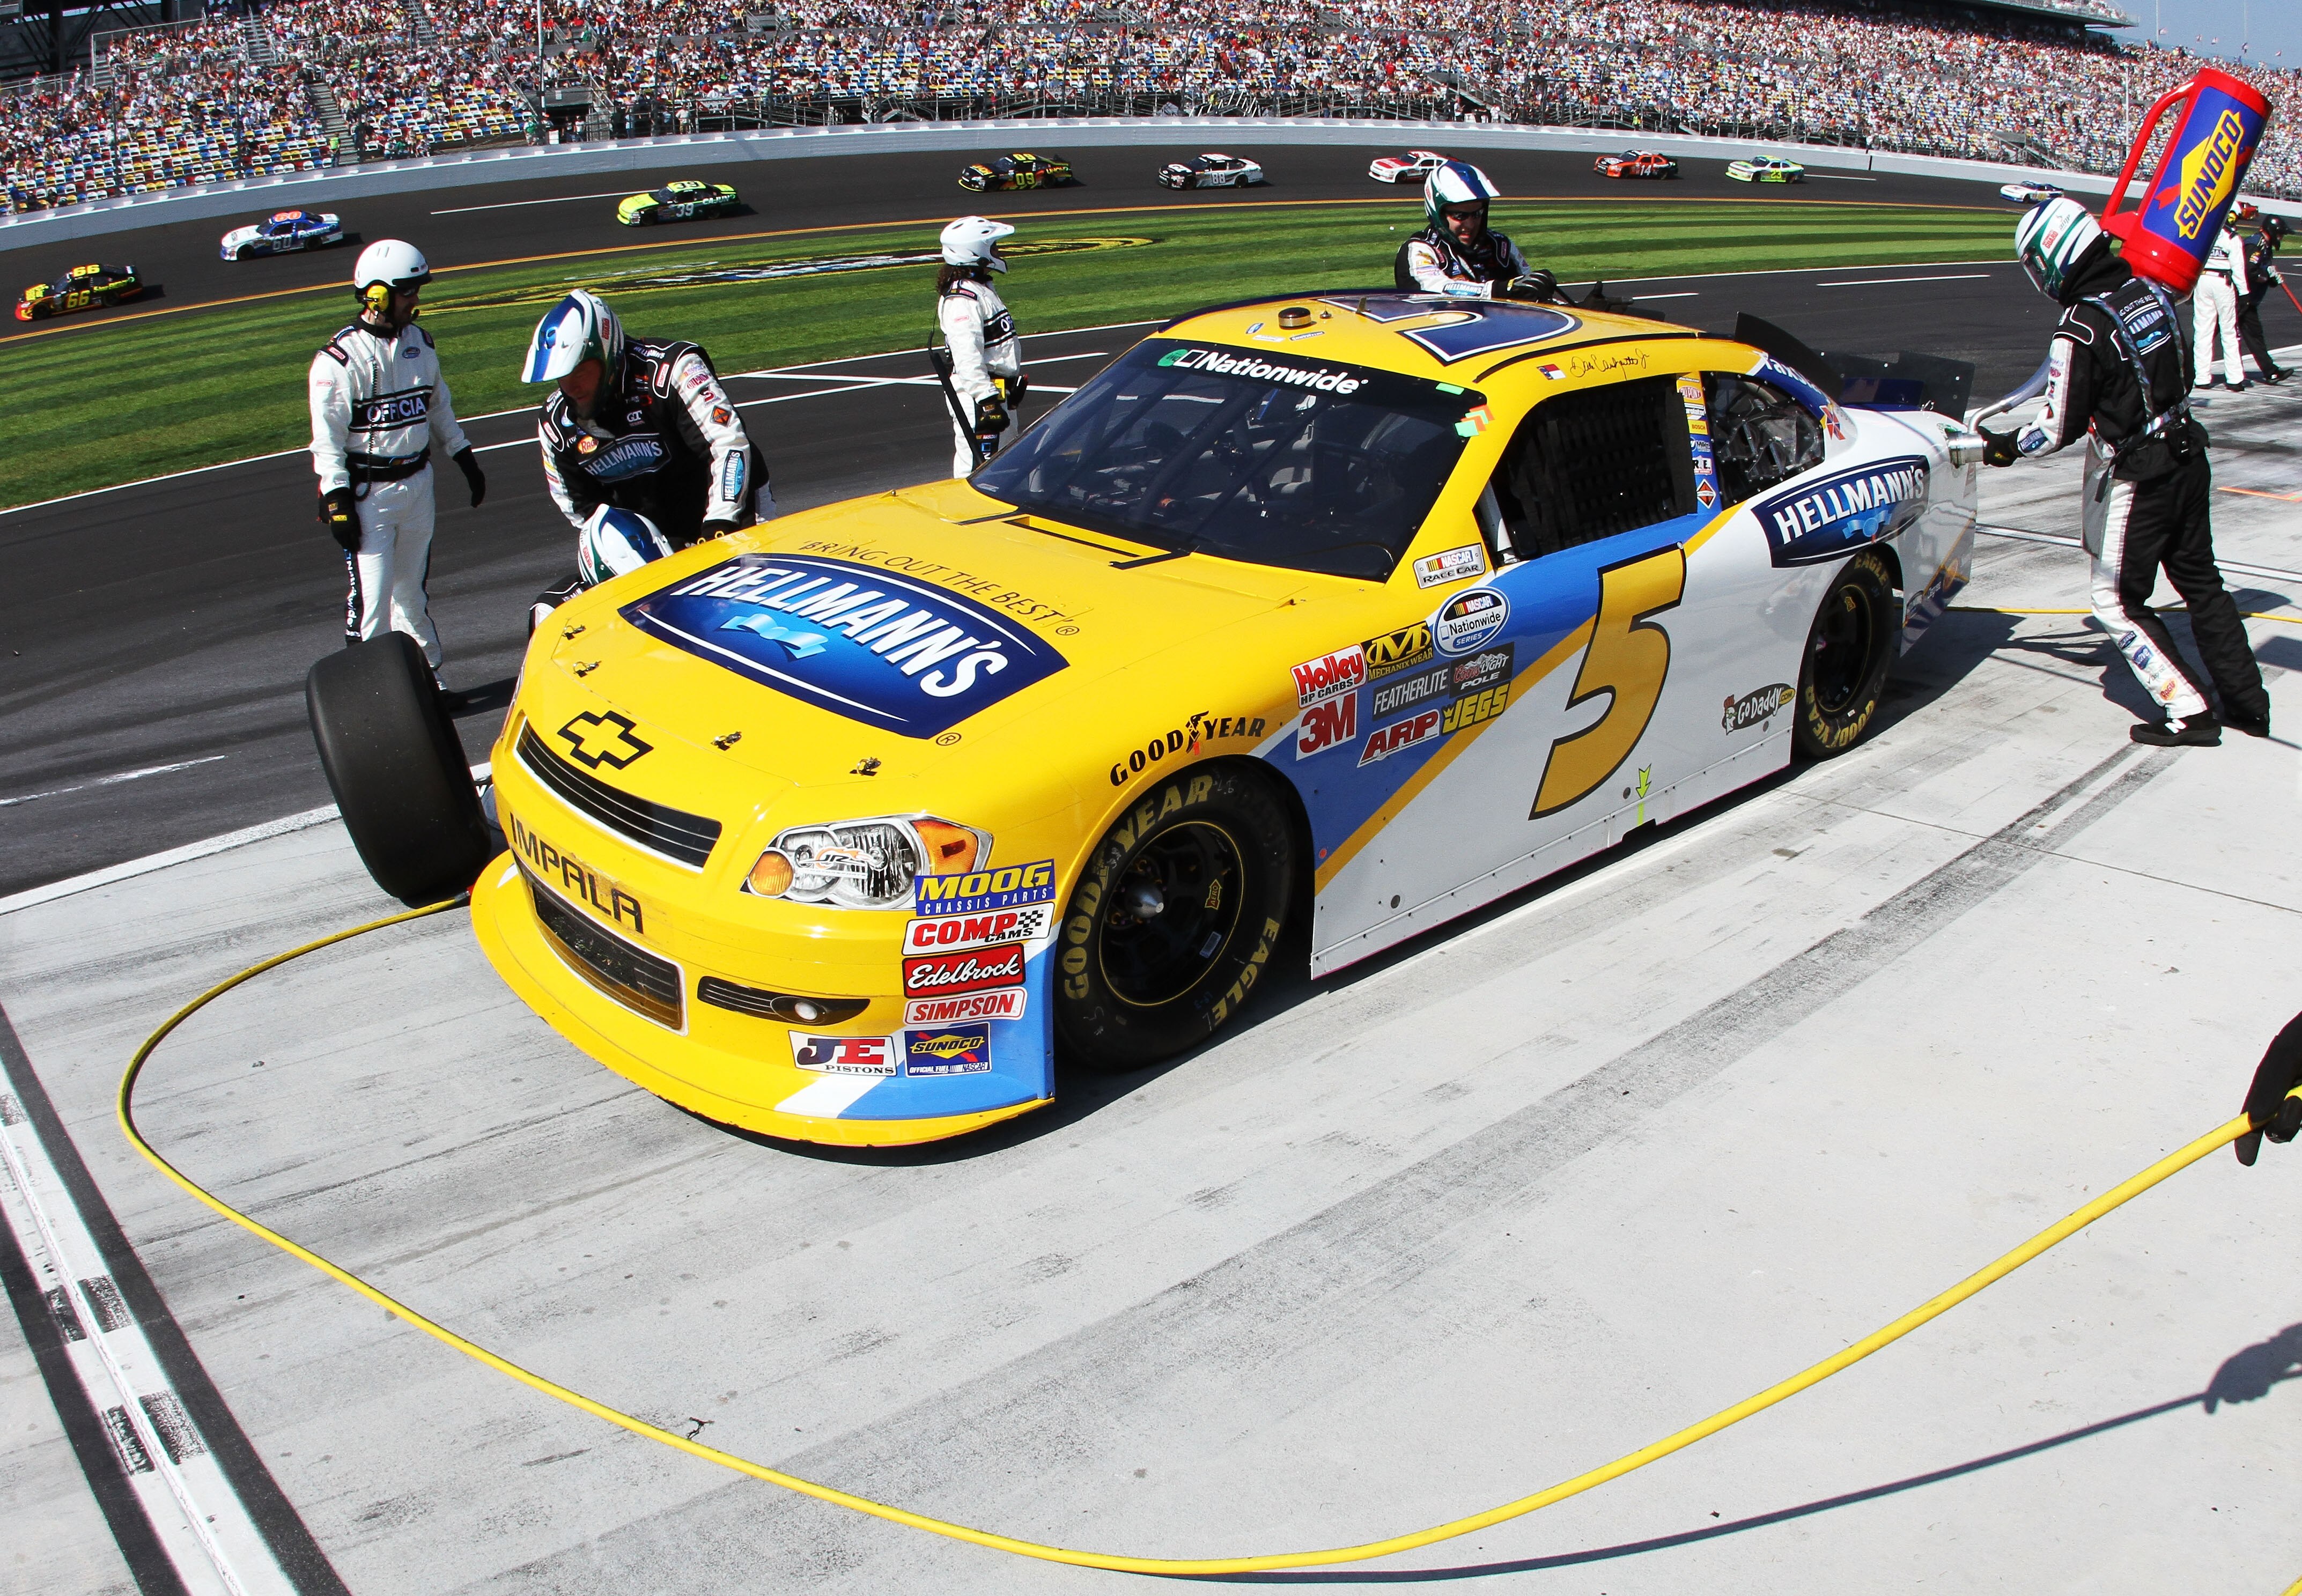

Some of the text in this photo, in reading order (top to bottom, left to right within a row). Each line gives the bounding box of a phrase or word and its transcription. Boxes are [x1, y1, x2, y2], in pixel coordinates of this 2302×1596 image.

[1015, 172, 1035, 185] 09
[1212, 172, 1226, 185] 88
[1640, 164, 1651, 176] 14
[1771, 169, 1782, 179] 23
[2179, 116, 2242, 231] SUNOCO
[676, 181, 699, 189] 39
[676, 203, 694, 217] 39
[703, 195, 731, 205] CAJUN
[274, 211, 302, 221] 60
[272, 234, 292, 250] 60
[2045, 231, 2058, 249] GUARD
[73, 265, 100, 277] 66
[67, 290, 91, 308] 66
[2135, 298, 2145, 307] THE
[1310, 296, 1583, 366] 5
[1195, 351, 1360, 394] Nationwide
[626, 410, 643, 422] GT
[584, 440, 663, 476] HELLMANN'S
[725, 452, 740, 500] HELLMANN'S
[1774, 465, 1924, 545] HELLMANN'S
[1441, 551, 1472, 567] NASCAR
[1855, 552, 1889, 586] EAGLE
[884, 557, 950, 575] OUT
[949, 572, 1001, 595] THE
[1423, 565, 1479, 583] RACE CAR
[1466, 596, 1493, 612] NASCAR
[670, 566, 1008, 698] HELLMANN'S
[1449, 612, 1501, 636] Nationwide
[1456, 632, 1482, 646] SERIES
[1294, 653, 1364, 696] Holley
[1368, 647, 1434, 681] MECHANIX WEAR
[1453, 654, 1510, 683] Coors LIGHT
[1301, 678, 1354, 705] HP CARBS
[1374, 668, 1449, 715] FEATHERLITE
[1460, 671, 1500, 690] POLE
[1529, 542, 1687, 821] 5
[1442, 683, 1510, 734] JEGS
[1299, 693, 1356, 753] 3M
[1362, 711, 1439, 760] ARP
[510, 811, 645, 935] IMPALA
[918, 862, 1052, 902] MOOG
[925, 888, 1047, 914] CHASSIS PARTS
[1211, 885, 1219, 906] AERO
[912, 913, 1018, 947] COMP
[984, 927, 1034, 943] CAMS
[907, 953, 1021, 988] Edelbrock
[1212, 917, 1280, 1026] EAGLE
[914, 993, 1016, 1021] SIMPSON
[796, 1038, 886, 1065] JE
[914, 1037, 982, 1052] SUNOCO
[825, 1064, 894, 1074] PISTONS
[935, 1065, 950, 1073] FUEL
[963, 1062, 986, 1071] NASCAR
